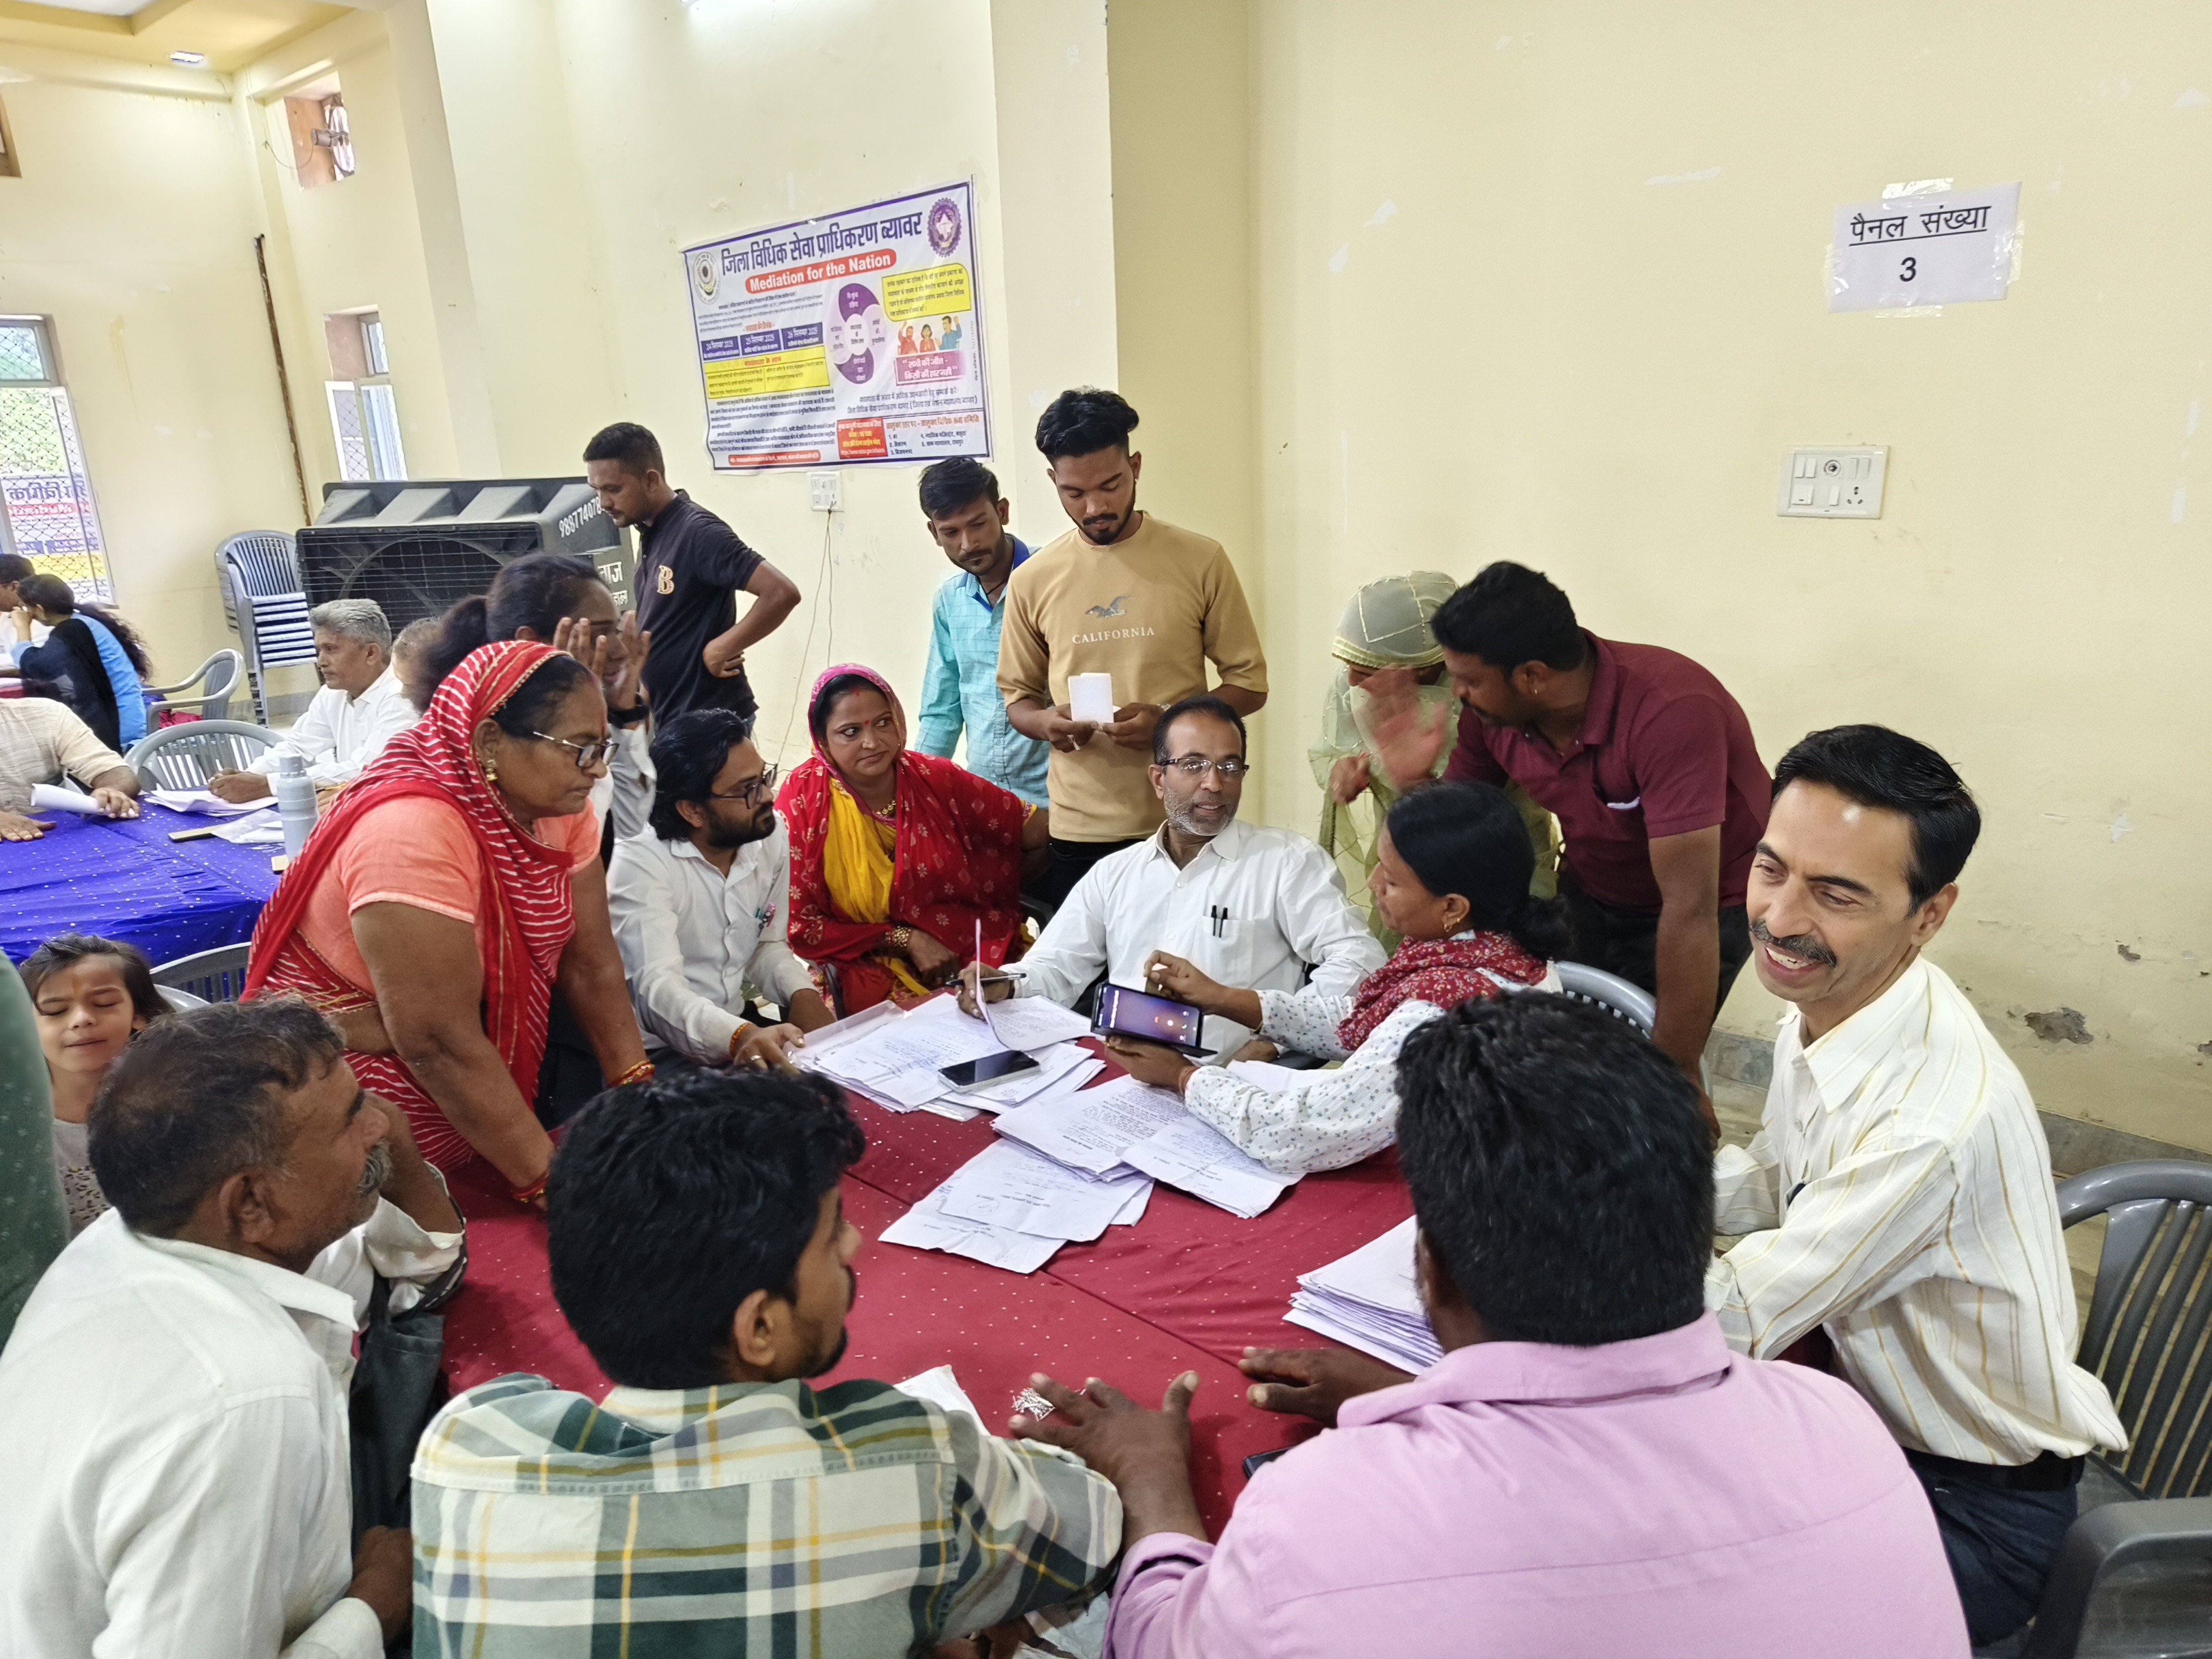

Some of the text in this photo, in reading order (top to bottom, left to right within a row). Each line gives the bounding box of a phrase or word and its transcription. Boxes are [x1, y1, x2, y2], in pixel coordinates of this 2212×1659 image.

[1850, 205, 1992, 241] पैनल संख्या
[721, 248, 750, 275] जिला
[751, 238, 787, 269] विधिक
[790, 232, 815, 261] सेवा
[816, 222, 878, 258] प्राधिकरण
[880, 212, 922, 239] ब्यावर
[750, 253, 892, 292] Mediation for the Nation
[1899, 257, 1917, 282] 3
[559, 496, 602, 538] 988774078
[657, 565, 675, 595] B
[1072, 627, 1155, 644] CALIFORNIA
